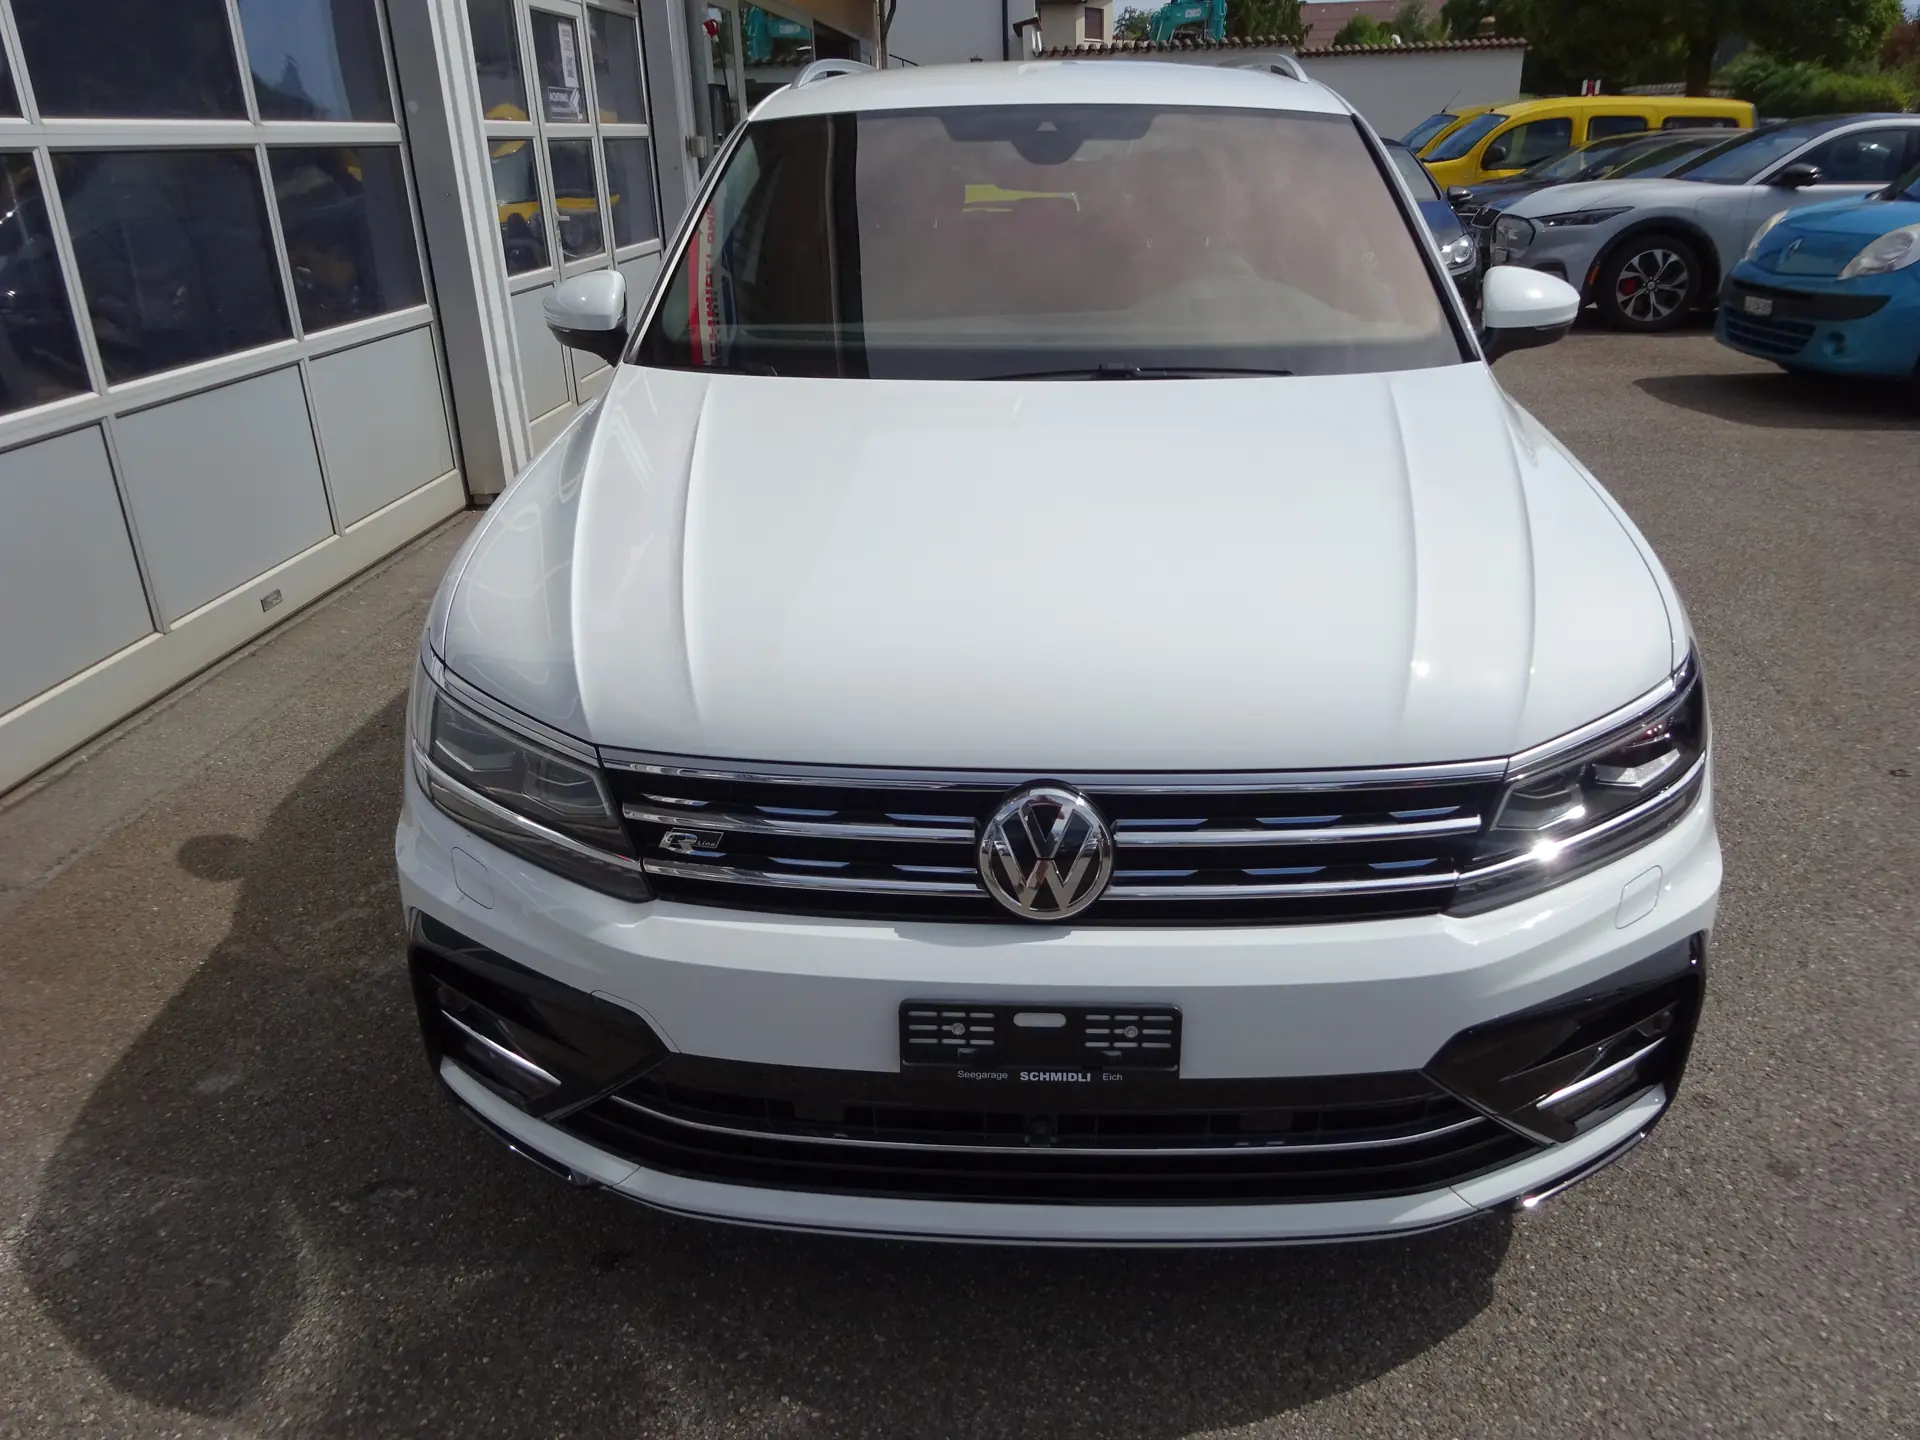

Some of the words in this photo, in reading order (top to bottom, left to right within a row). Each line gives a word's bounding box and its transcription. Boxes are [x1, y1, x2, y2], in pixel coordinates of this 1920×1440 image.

[957, 1069, 1008, 1081] Seegarage
[1019, 1071, 1091, 1082] SCHMIDLI
[1102, 1072, 1123, 1081] Eich
